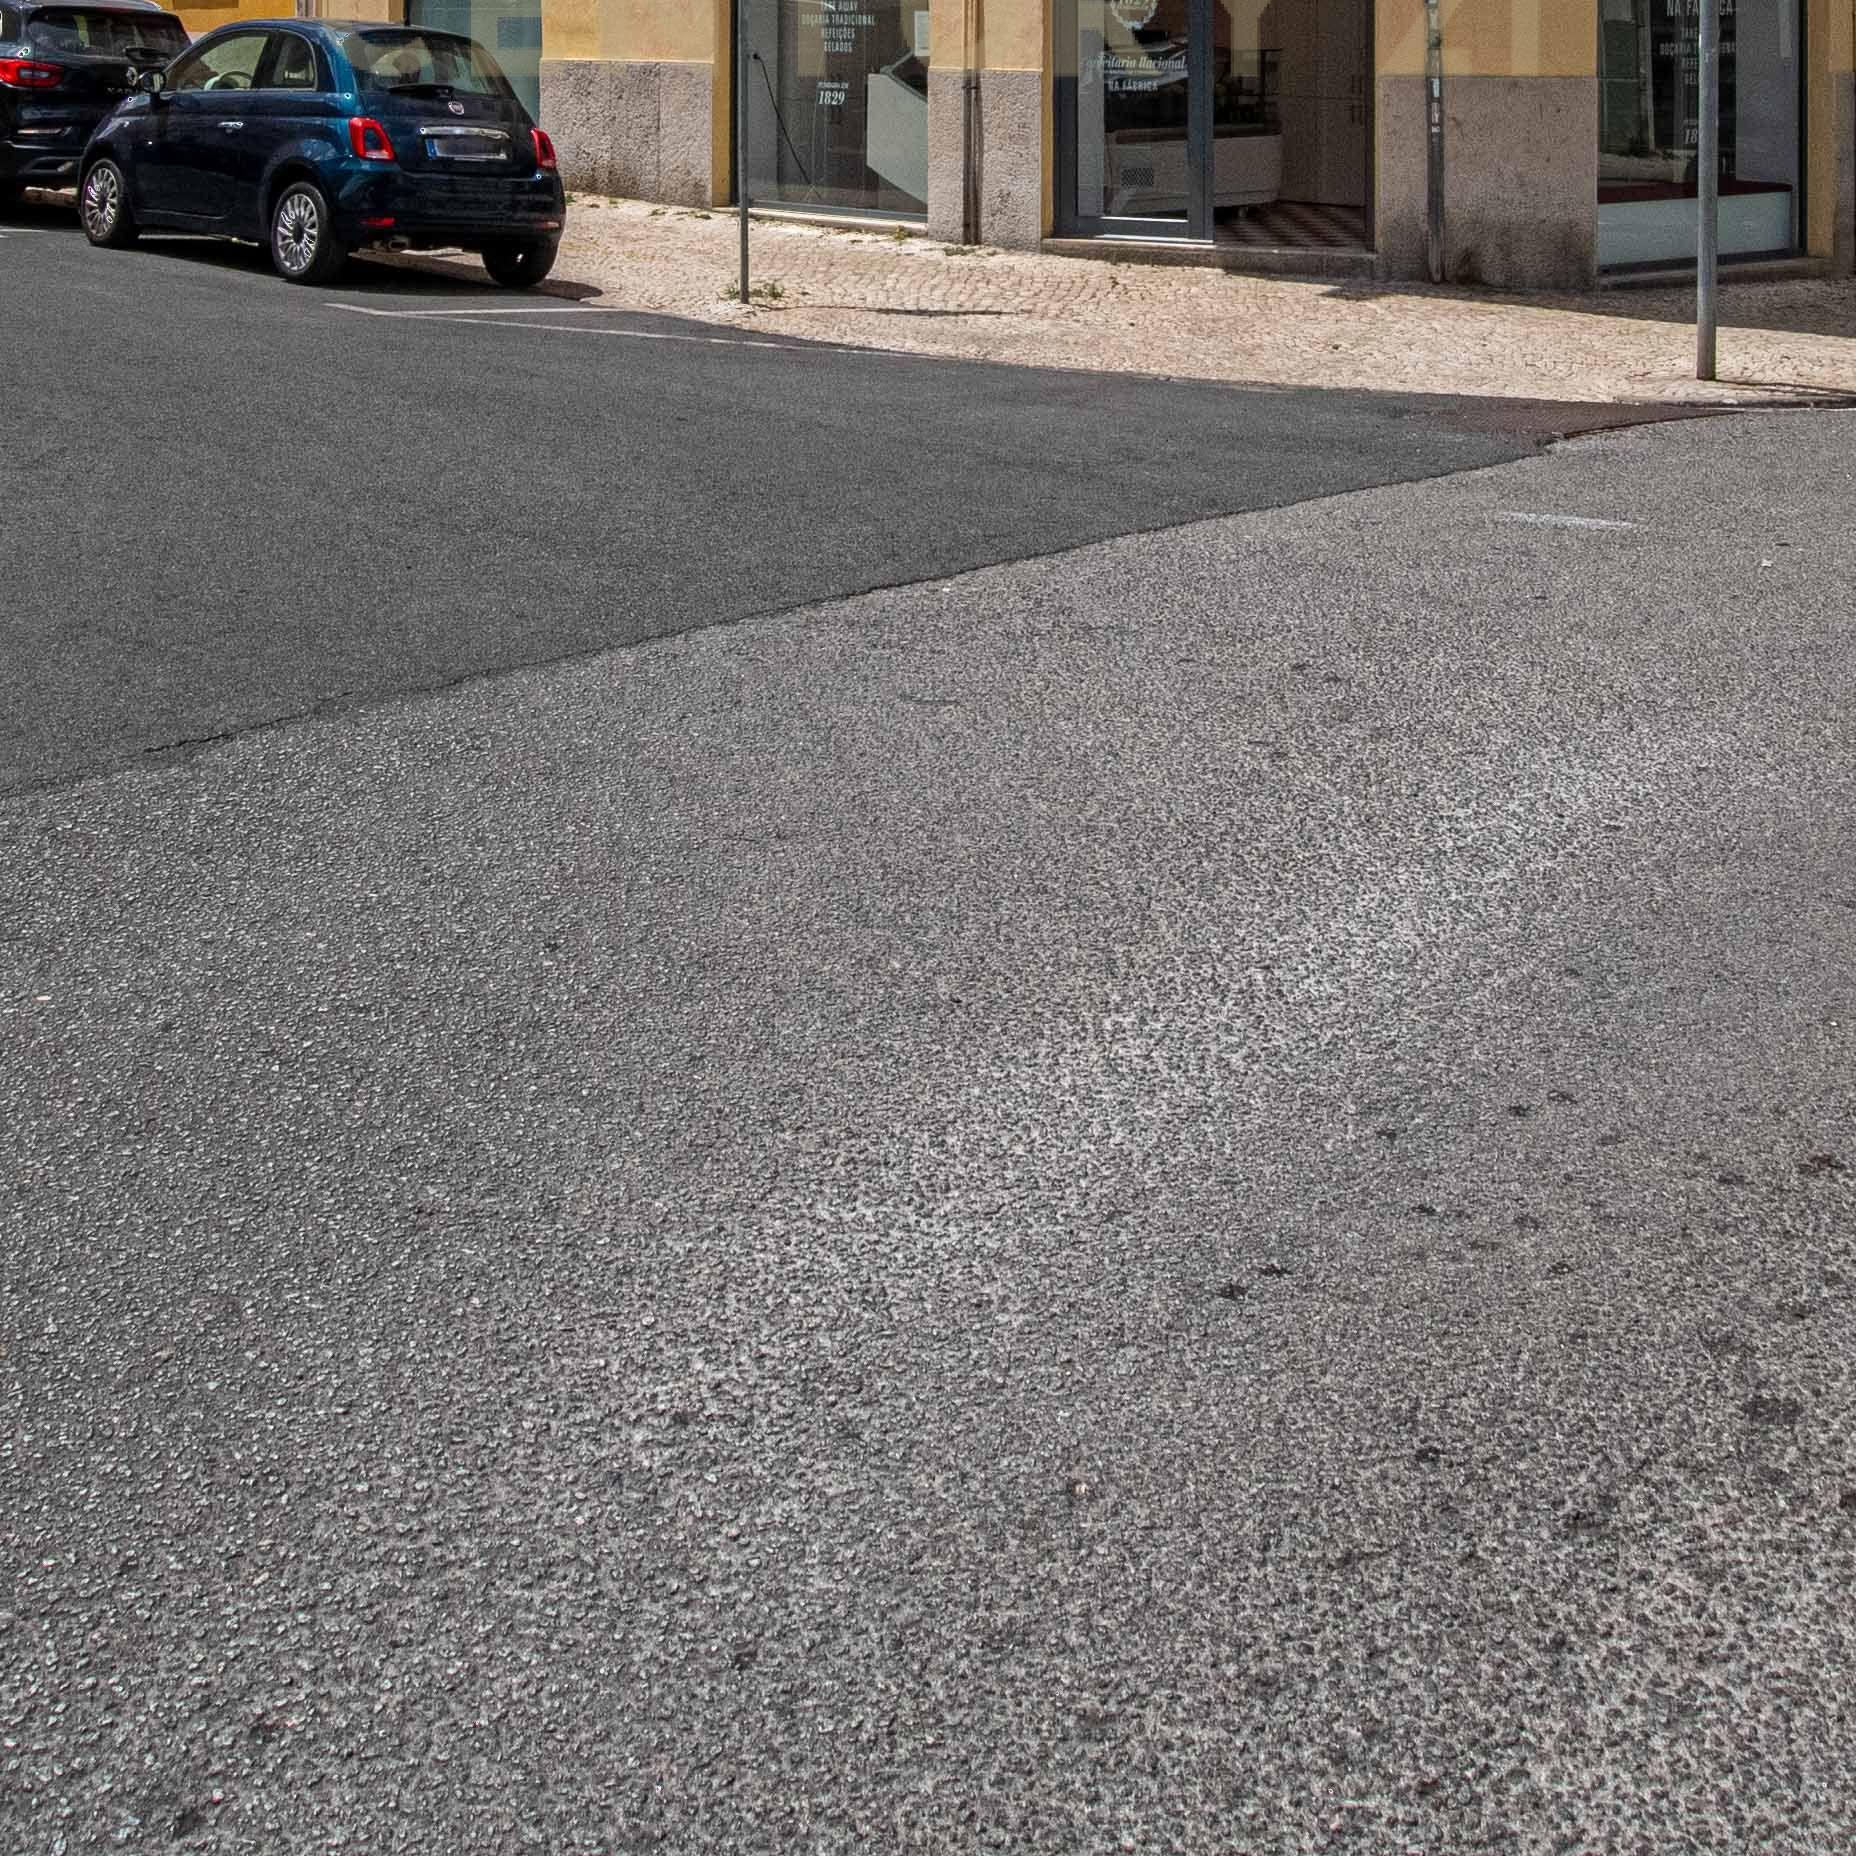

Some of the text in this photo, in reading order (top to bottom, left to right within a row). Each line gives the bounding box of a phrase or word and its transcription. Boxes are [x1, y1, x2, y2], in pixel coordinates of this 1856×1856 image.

[1666, 0, 1681, 17] NA
[1138, 55, 1187, 70] Nacional
[818, 90, 846, 105] 1829
